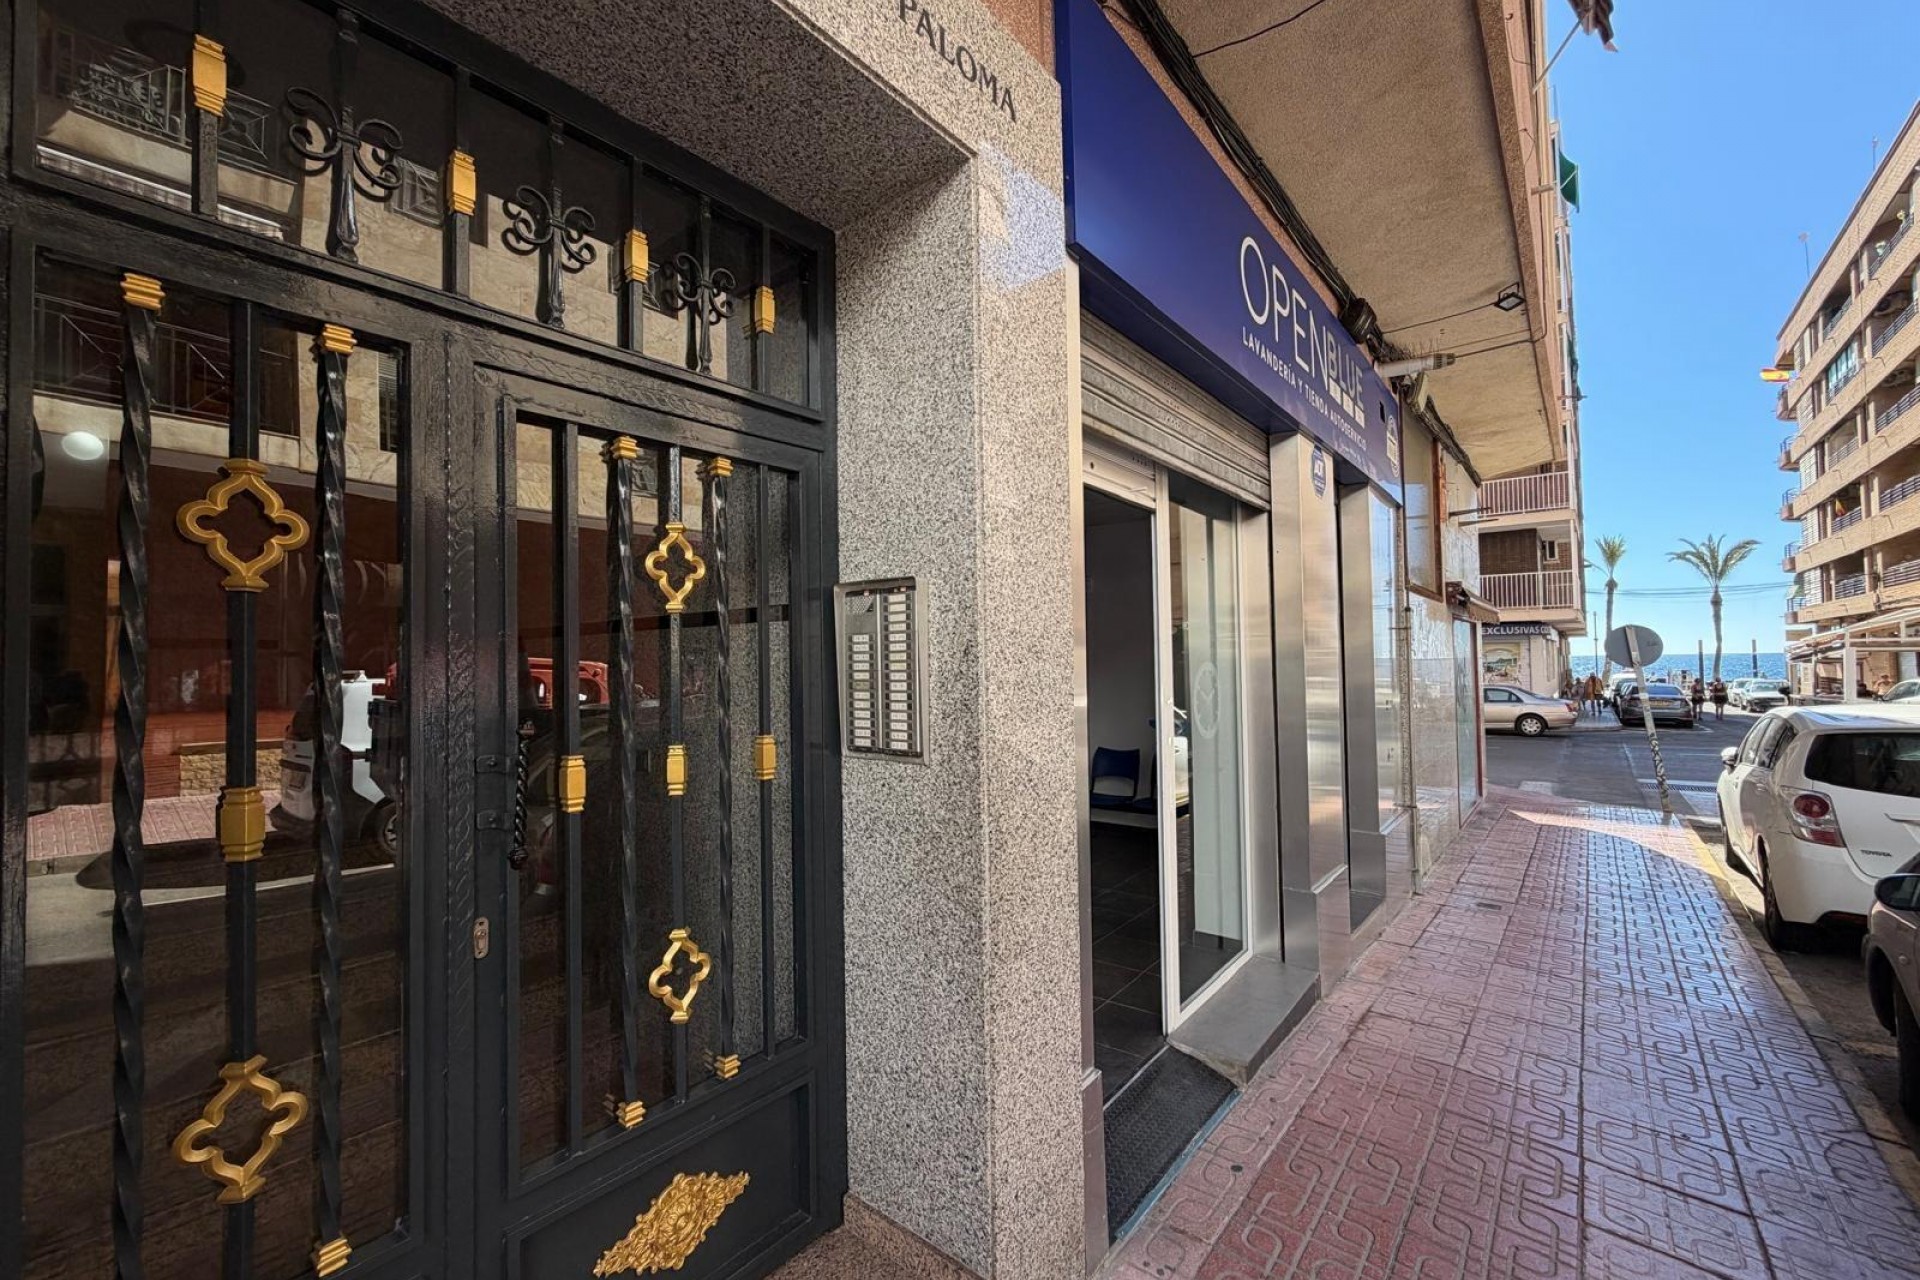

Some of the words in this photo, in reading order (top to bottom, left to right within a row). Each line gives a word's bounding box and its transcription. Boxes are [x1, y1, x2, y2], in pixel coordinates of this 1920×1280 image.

[1242, 325, 1297, 389] LAVANDERÍA
[1297, 378, 1304, 393] Y
[1304, 384, 1330, 418] TIENDA
[1481, 626, 1540, 635] EXCLUSIVAS
